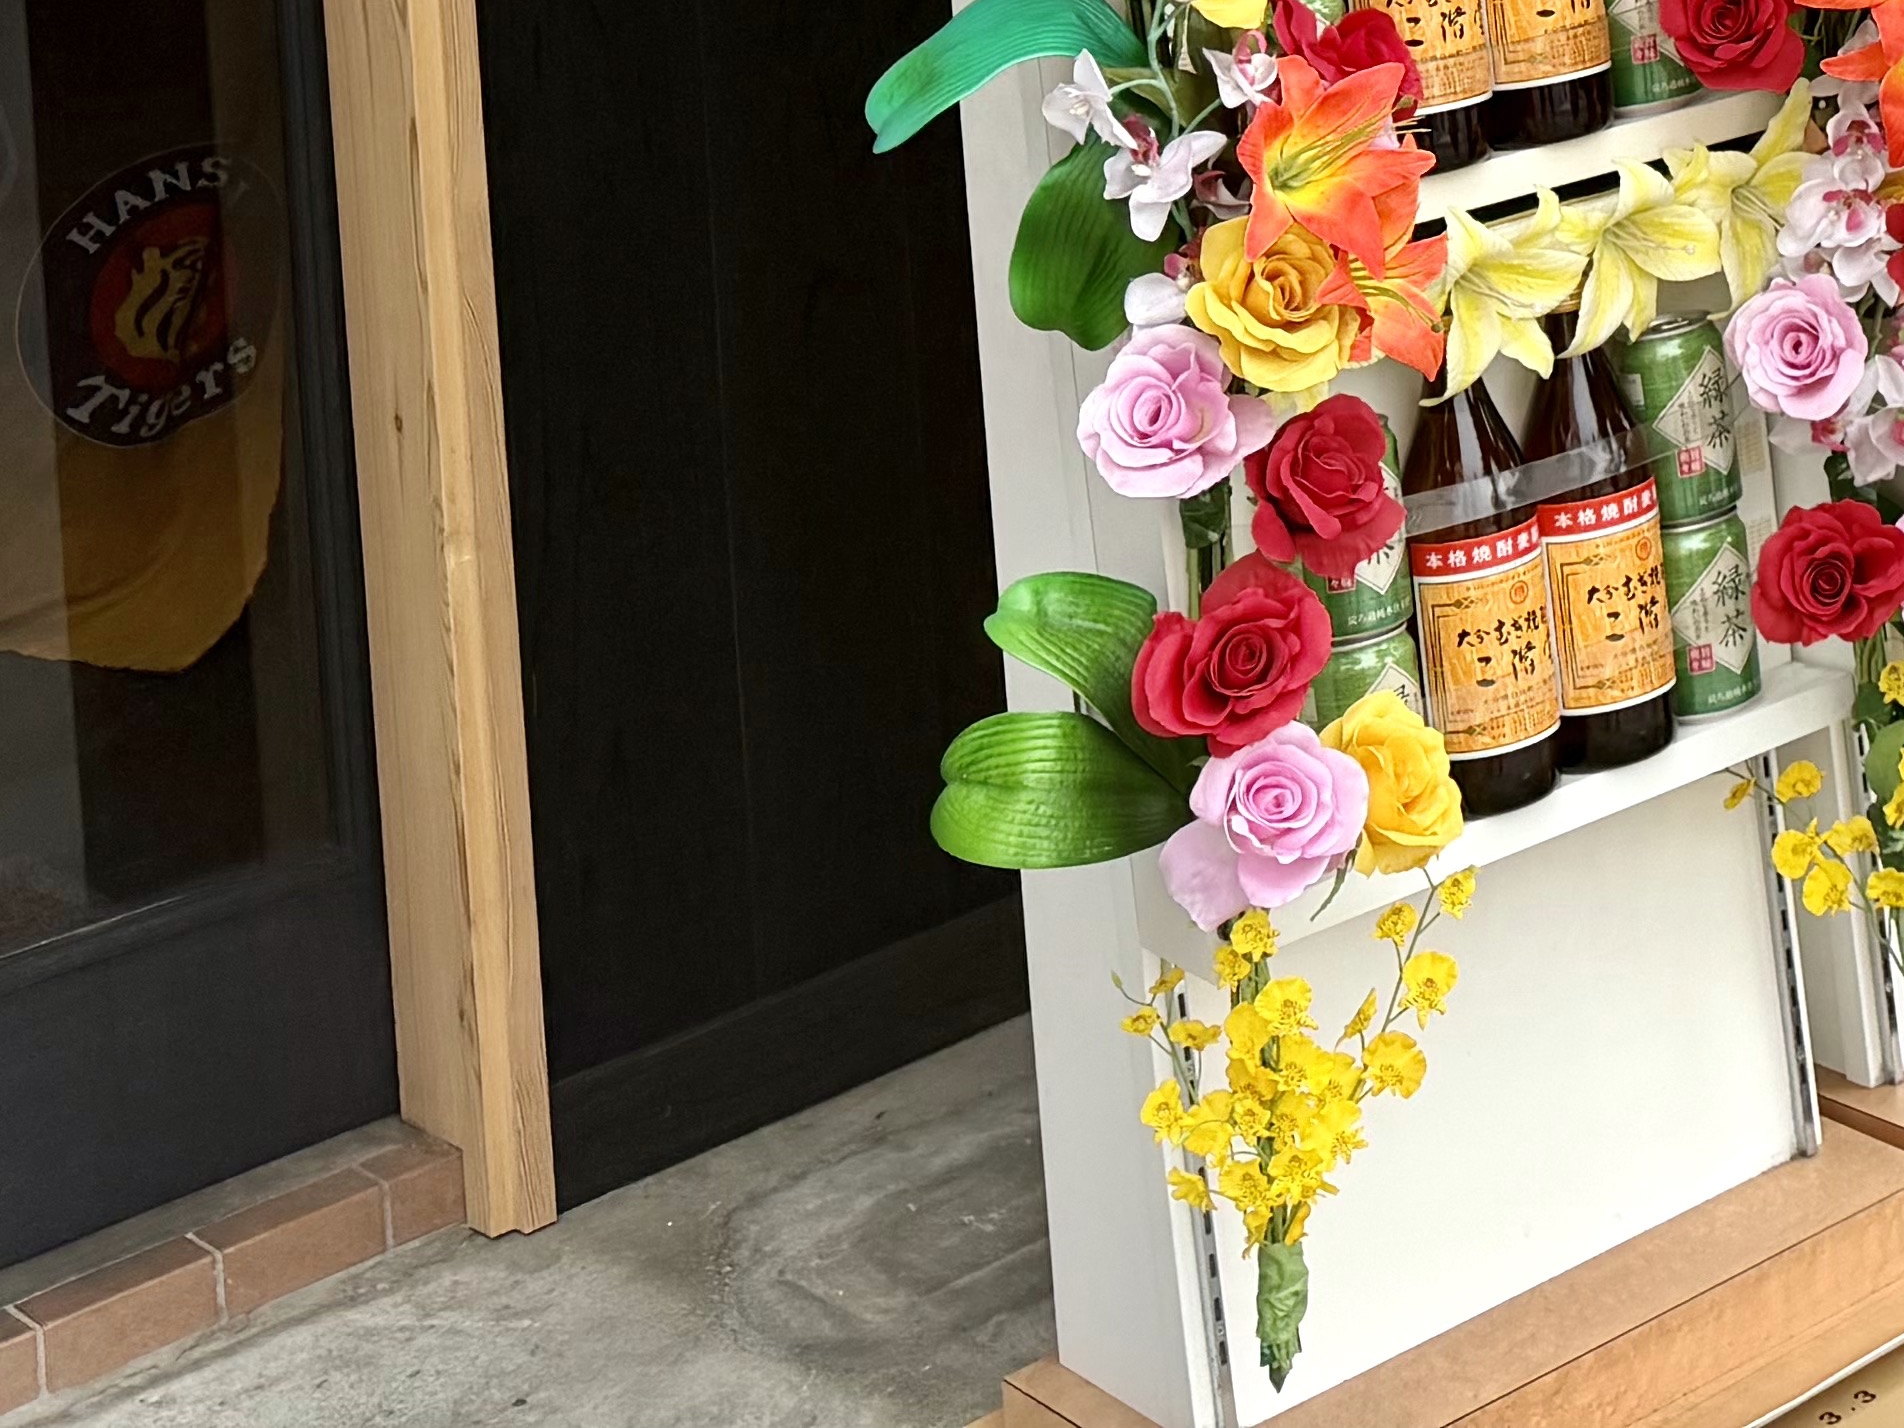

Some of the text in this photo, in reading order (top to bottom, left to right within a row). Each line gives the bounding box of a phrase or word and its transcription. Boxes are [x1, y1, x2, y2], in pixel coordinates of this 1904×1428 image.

[66, 155, 250, 255] HANS
[66, 335, 257, 438] Tigers
[1699, 367, 1733, 450] 緑茶
[1554, 484, 1657, 529] 本格焼酎麦
[1587, 562, 1665, 605] 大分むぎ焼
[1712, 563, 1747, 649] 緑茶
